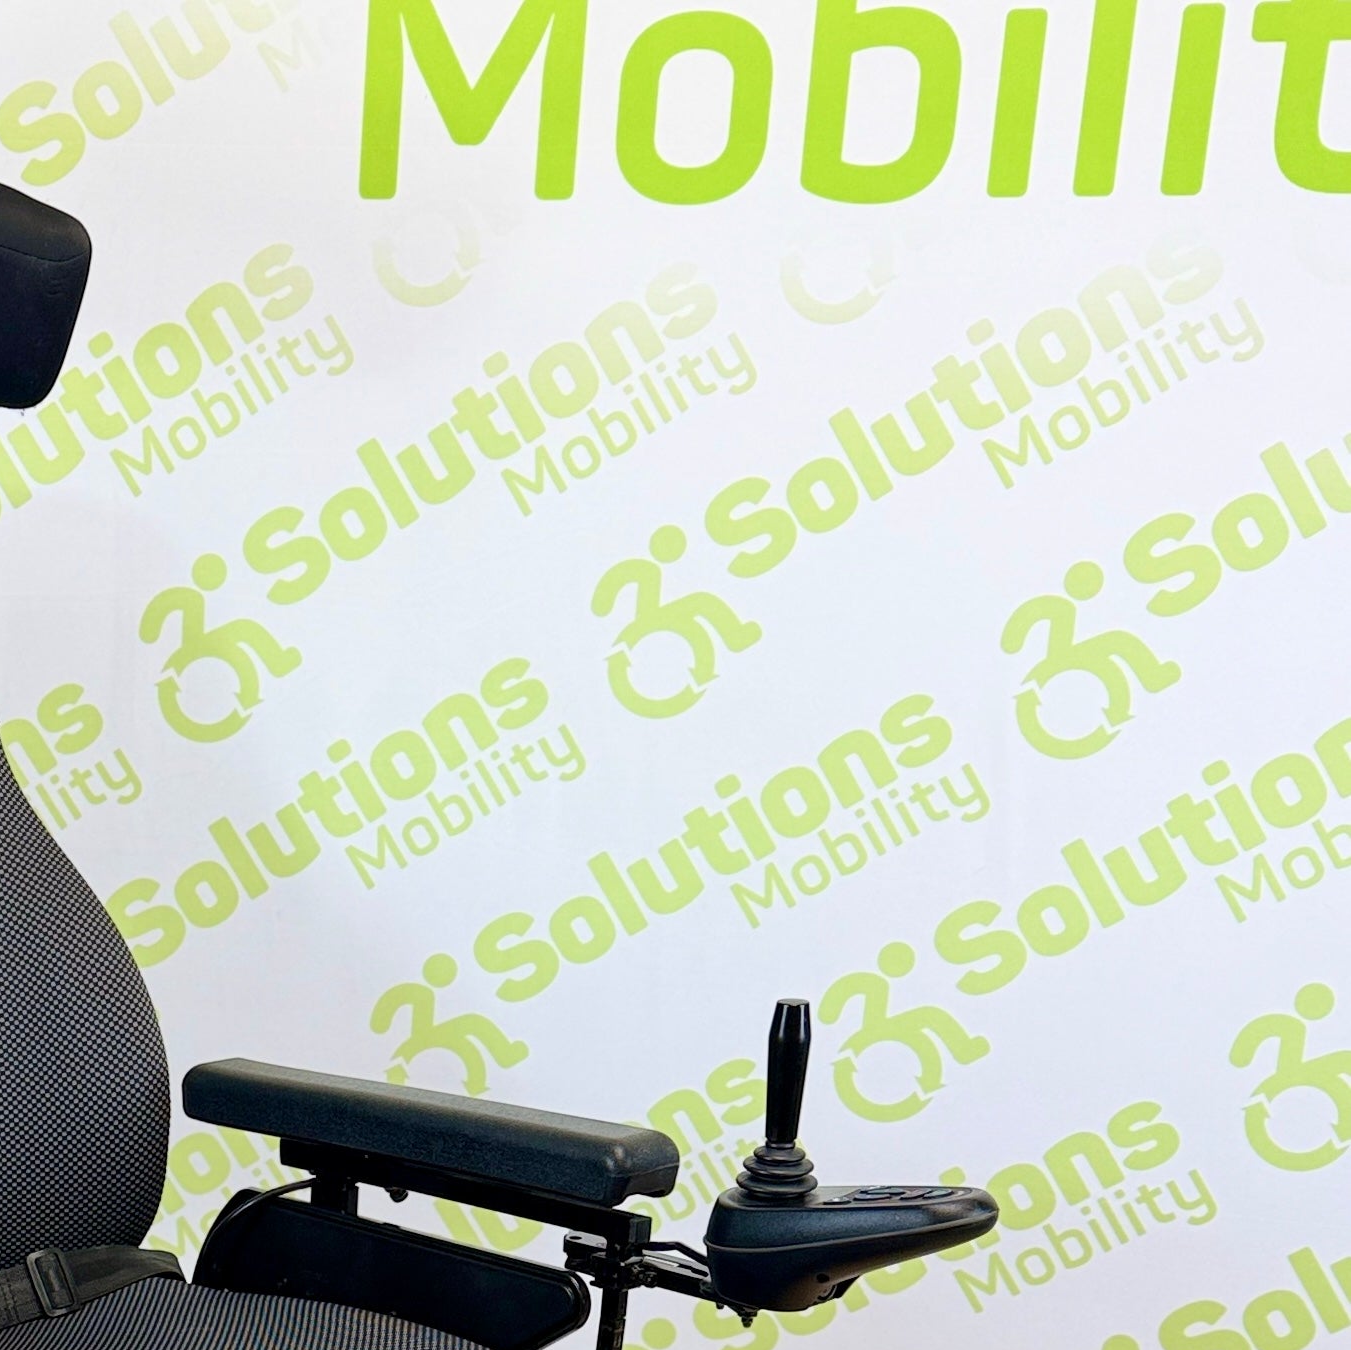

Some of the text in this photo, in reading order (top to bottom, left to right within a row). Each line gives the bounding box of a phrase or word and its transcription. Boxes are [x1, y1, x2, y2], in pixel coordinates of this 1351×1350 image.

[110, 314, 355, 498] Mobility
[242, 261, 718, 605] Solutions
[500, 333, 758, 517] Mobility
[703, 228, 1225, 579] Solutions
[980, 297, 1265, 490] Mobility
[104, 657, 549, 968] Solutions
[345, 724, 586, 889] Mobility
[473, 694, 952, 1002] Solutions
[730, 763, 991, 929] Mobility
[954, 1169, 1218, 1313] Mobility
